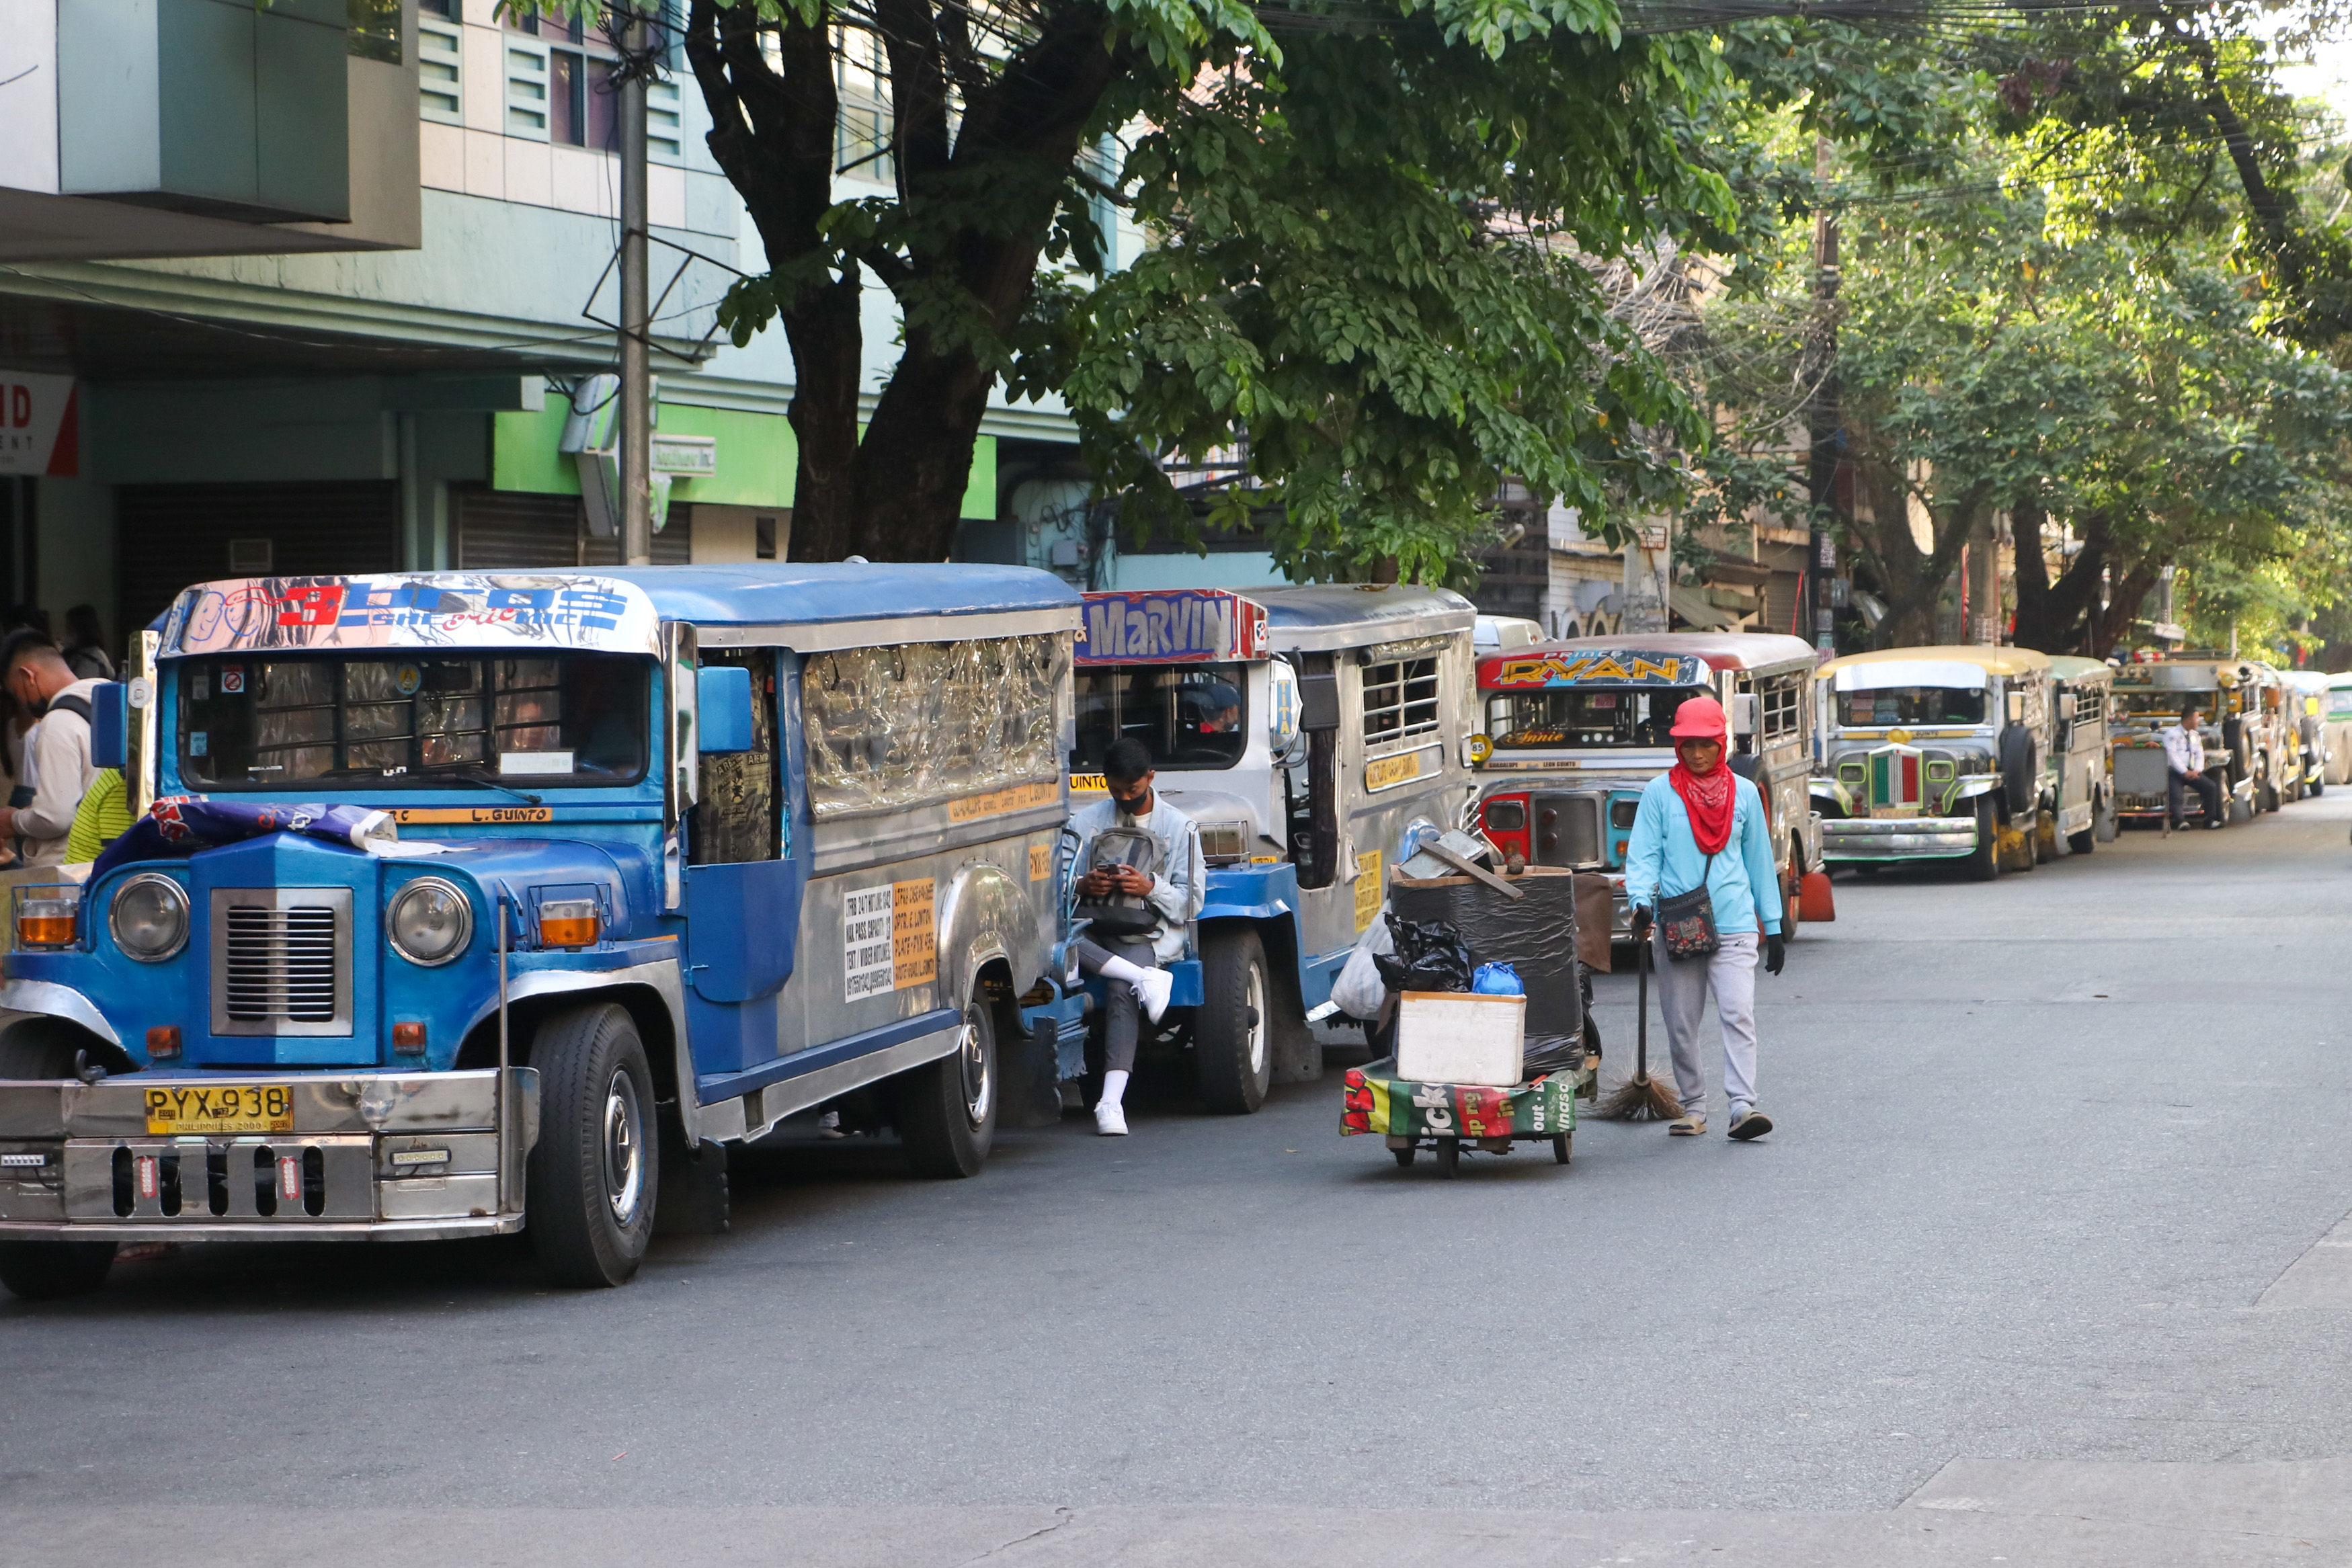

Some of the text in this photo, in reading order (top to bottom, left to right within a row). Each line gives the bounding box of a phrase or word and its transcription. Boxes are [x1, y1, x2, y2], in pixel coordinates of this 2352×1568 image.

[1543, 650, 1623, 659] PRINCE
[1499, 656, 1683, 685] RYAN
[1279, 680, 1290, 734] TITA
[1069, 776, 1108, 788] UINTO
[151, 1088, 284, 1120] PYX 938
